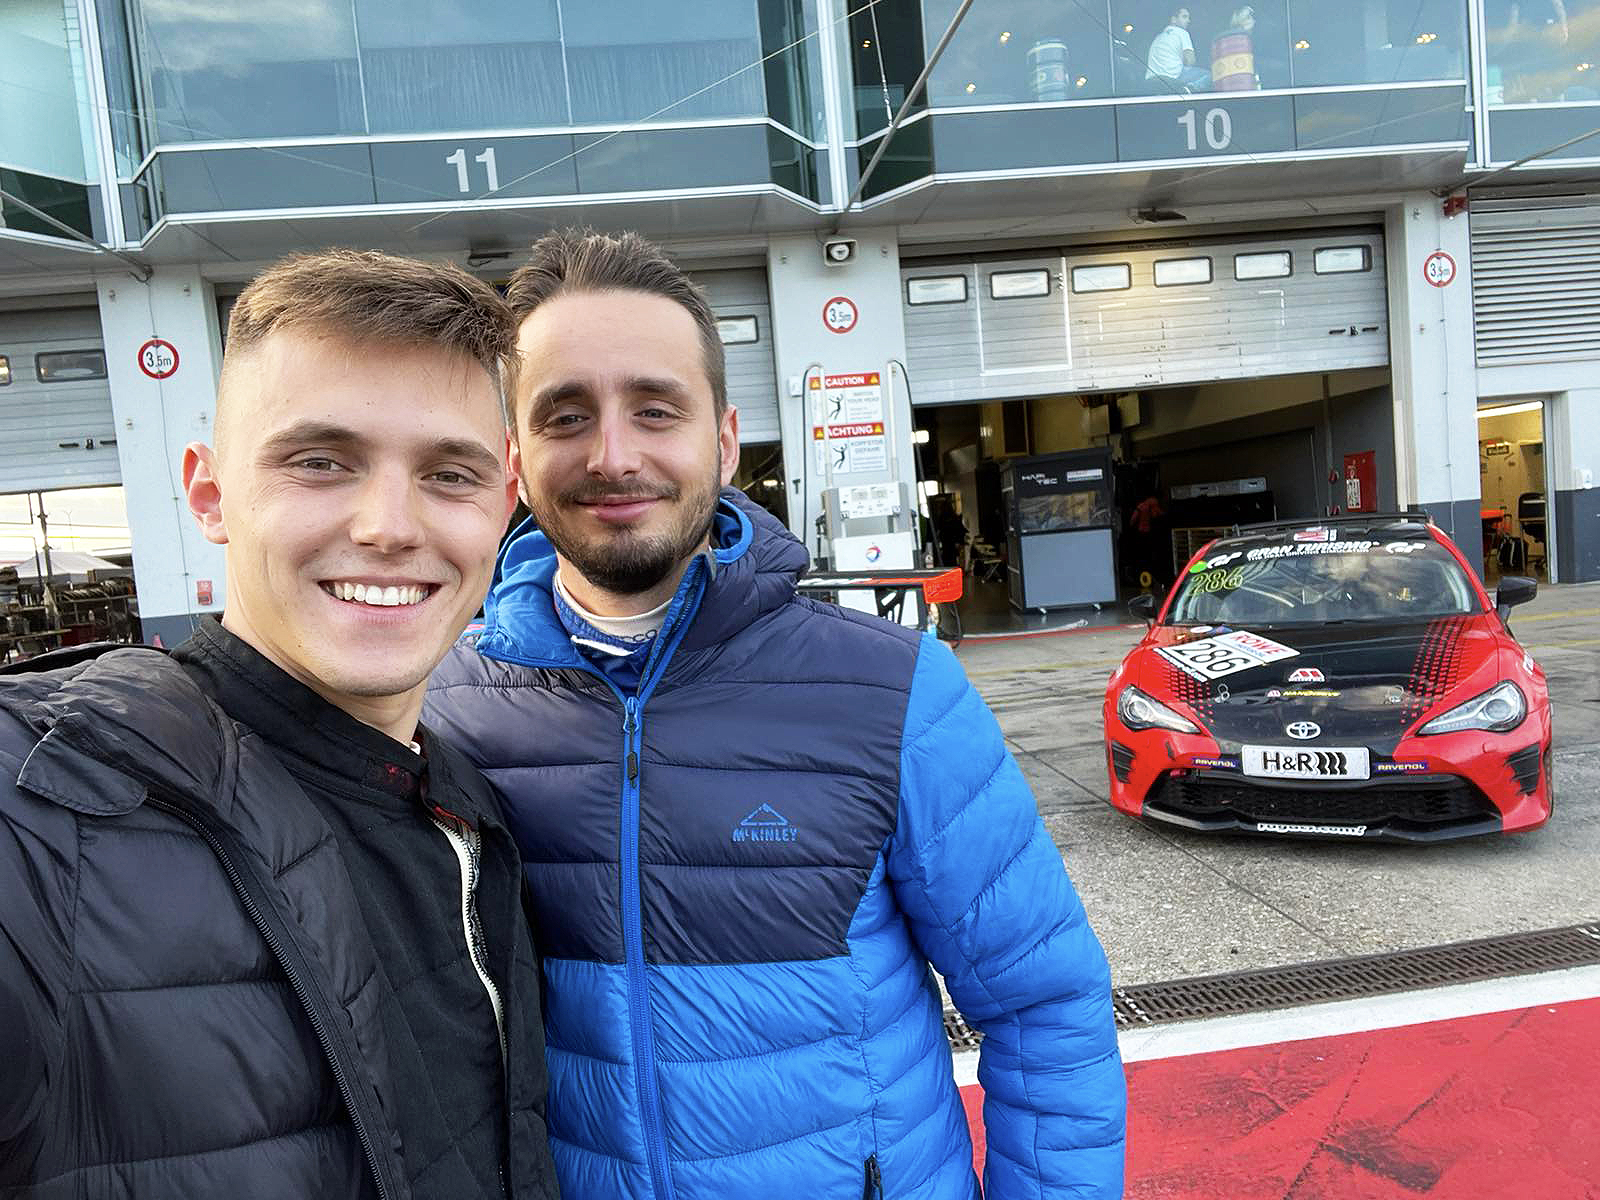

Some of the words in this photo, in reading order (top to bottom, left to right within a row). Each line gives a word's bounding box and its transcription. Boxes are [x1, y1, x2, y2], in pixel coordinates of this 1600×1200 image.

[1176, 107, 1232, 151] 10
[446, 147, 499, 193] 11
[825, 376, 865, 387] CAUTION
[1247, 544, 1294, 557] GRAN
[1190, 567, 1244, 595] 286
[1231, 634, 1288, 655] ROWE
[1172, 642, 1251, 672] 286
[1195, 758, 1236, 768] RAVENOL
[1263, 751, 1314, 772] H&R
[1377, 763, 1425, 771] RAVENOL
